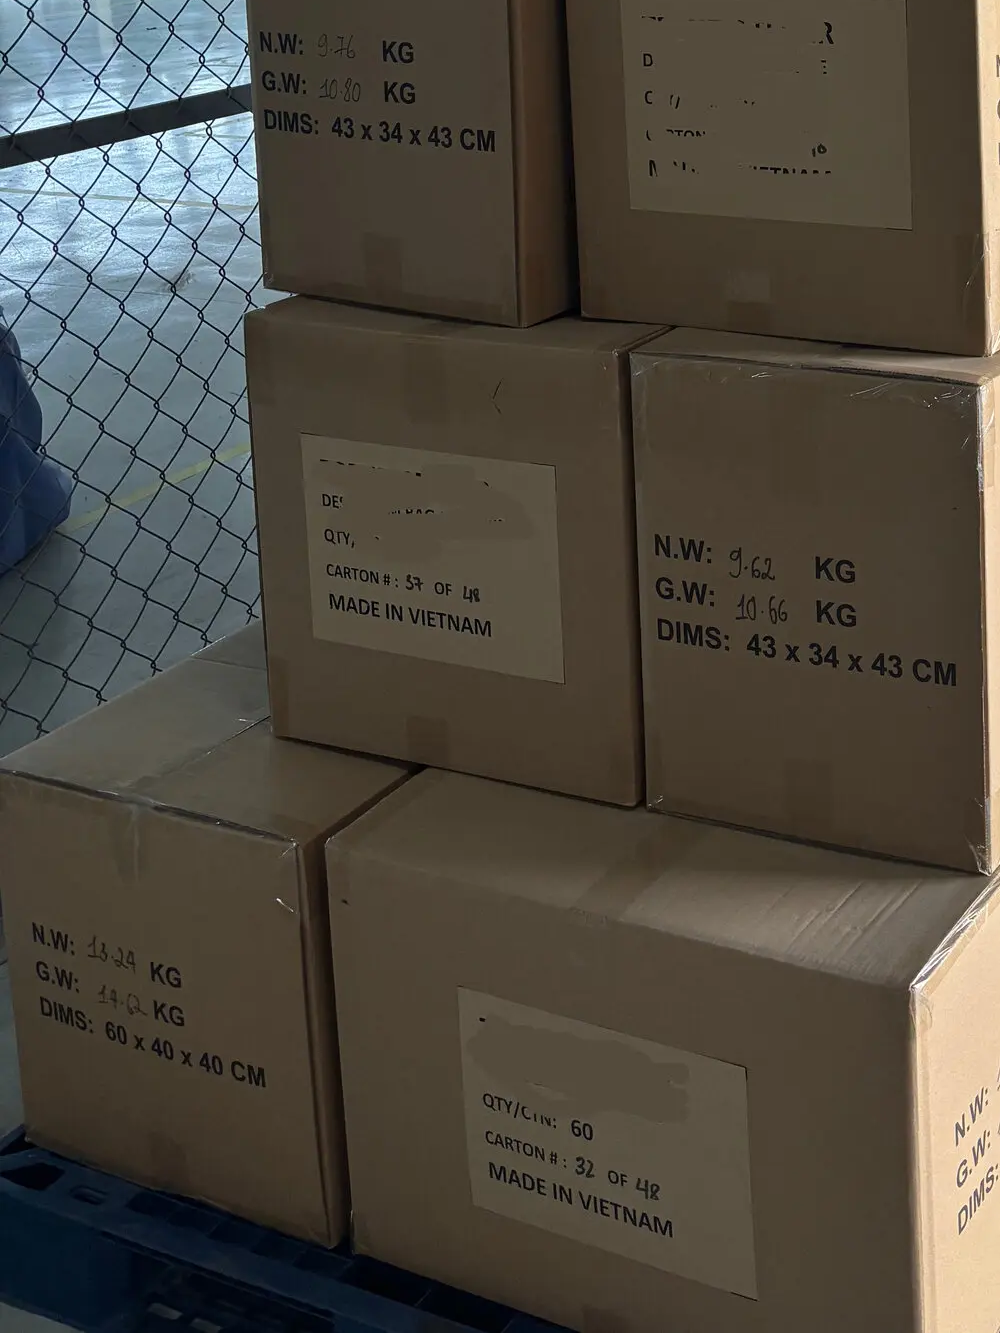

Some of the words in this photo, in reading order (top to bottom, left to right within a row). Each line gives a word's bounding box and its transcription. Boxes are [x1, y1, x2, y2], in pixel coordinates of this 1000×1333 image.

[259, 31, 304, 55] N.W:
[382, 39, 414, 64] KG
[261, 70, 307, 95] G.W:
[384, 81, 416, 104] KG
[263, 108, 319, 135] DIMS:
[332, 116, 355, 139] 43
[379, 120, 403, 144] 34
[428, 126, 452, 148] 43
[460, 127, 496, 152] CM
[654, 533, 712, 564] N.W:
[728, 546, 775, 581] 9.62
[814, 556, 856, 583] KG
[326, 564, 379, 585] CARTON
[434, 582, 452, 596] OF
[462, 586, 480, 603] 48
[655, 576, 715, 606] G.W:
[735, 595, 788, 625] 10.66
[816, 600, 856, 627] KG
[329, 593, 380, 618] MADE
[385, 603, 403, 622] IN
[408, 607, 492, 637] VIETNAM
[31, 922, 75, 956] N.W:
[150, 961, 183, 989] KG
[36, 960, 79, 994] G.W:
[152, 1000, 185, 1027] KG
[39, 995, 95, 1034] DIMS:
[105, 1021, 127, 1045] 60
[151, 1037, 175, 1061] 40
[200, 1052, 223, 1076] 40
[230, 1061, 267, 1088] CM
[570, 1119, 593, 1141] 60
[954, 1087, 988, 1147] N.W:
[488, 1161, 547, 1196] MADE
[552, 1182, 573, 1205] IN
[579, 1190, 674, 1238] VIETNAM
[575, 1155, 595, 1178] 32
[608, 1170, 628, 1187] OF
[635, 1178, 660, 1201] 48
